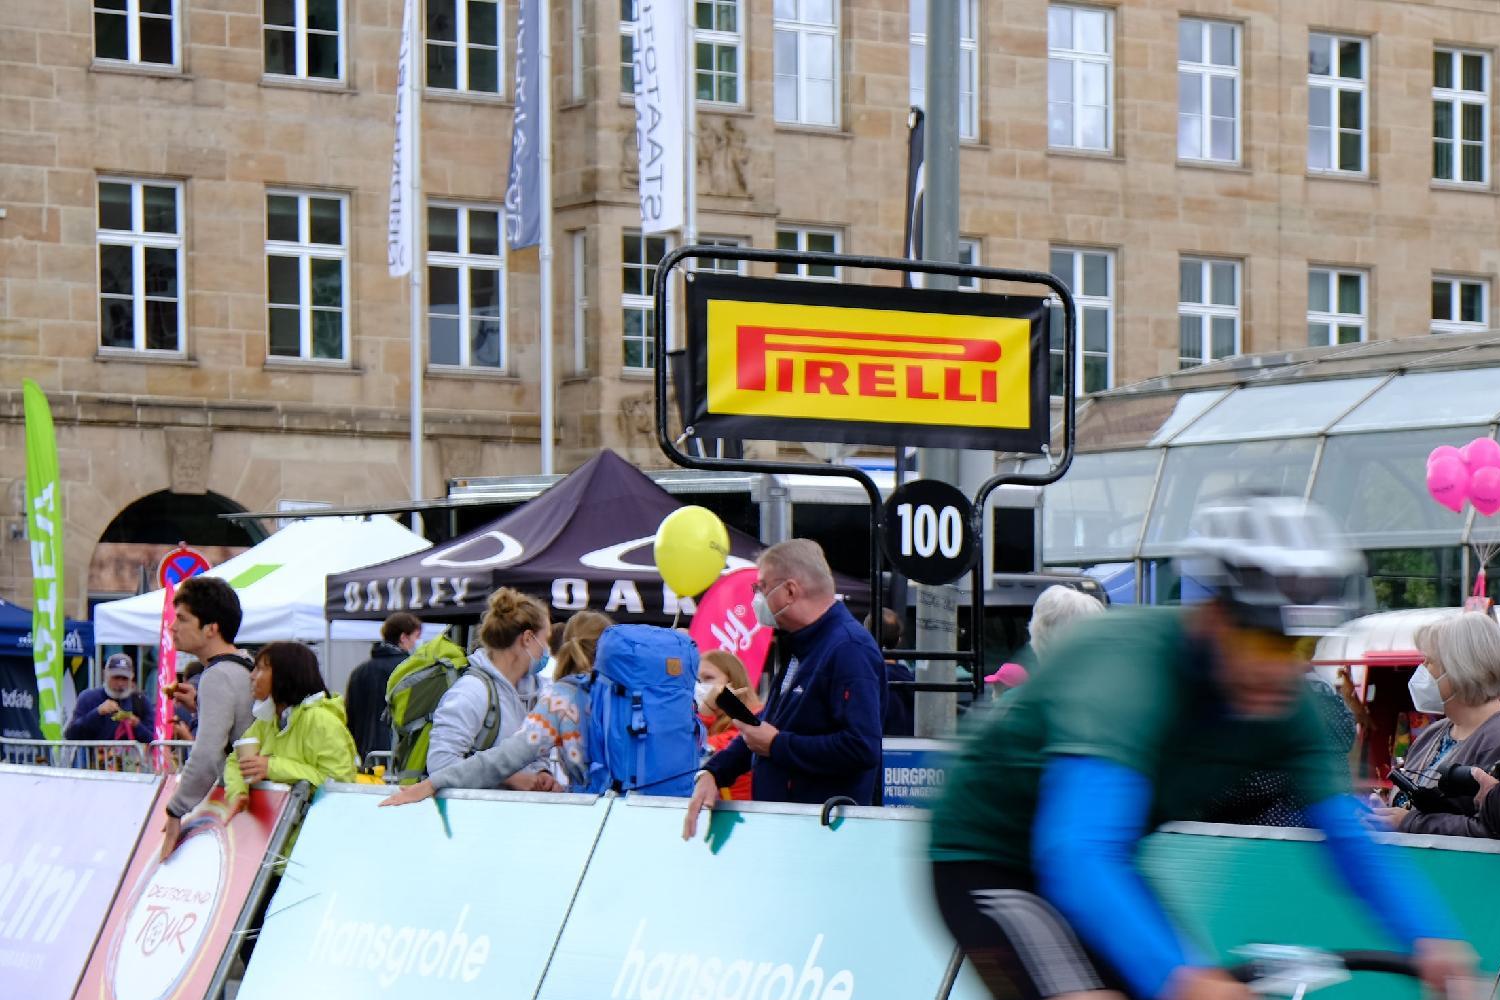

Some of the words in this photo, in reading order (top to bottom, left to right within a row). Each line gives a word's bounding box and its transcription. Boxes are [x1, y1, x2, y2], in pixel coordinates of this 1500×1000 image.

[736, 324, 1001, 404] PIRELLI
[897, 503, 963, 559] 100
[343, 576, 472, 612] OAKLEY
[884, 786, 909, 797] PETER
[308, 891, 491, 989] hansgrohe
